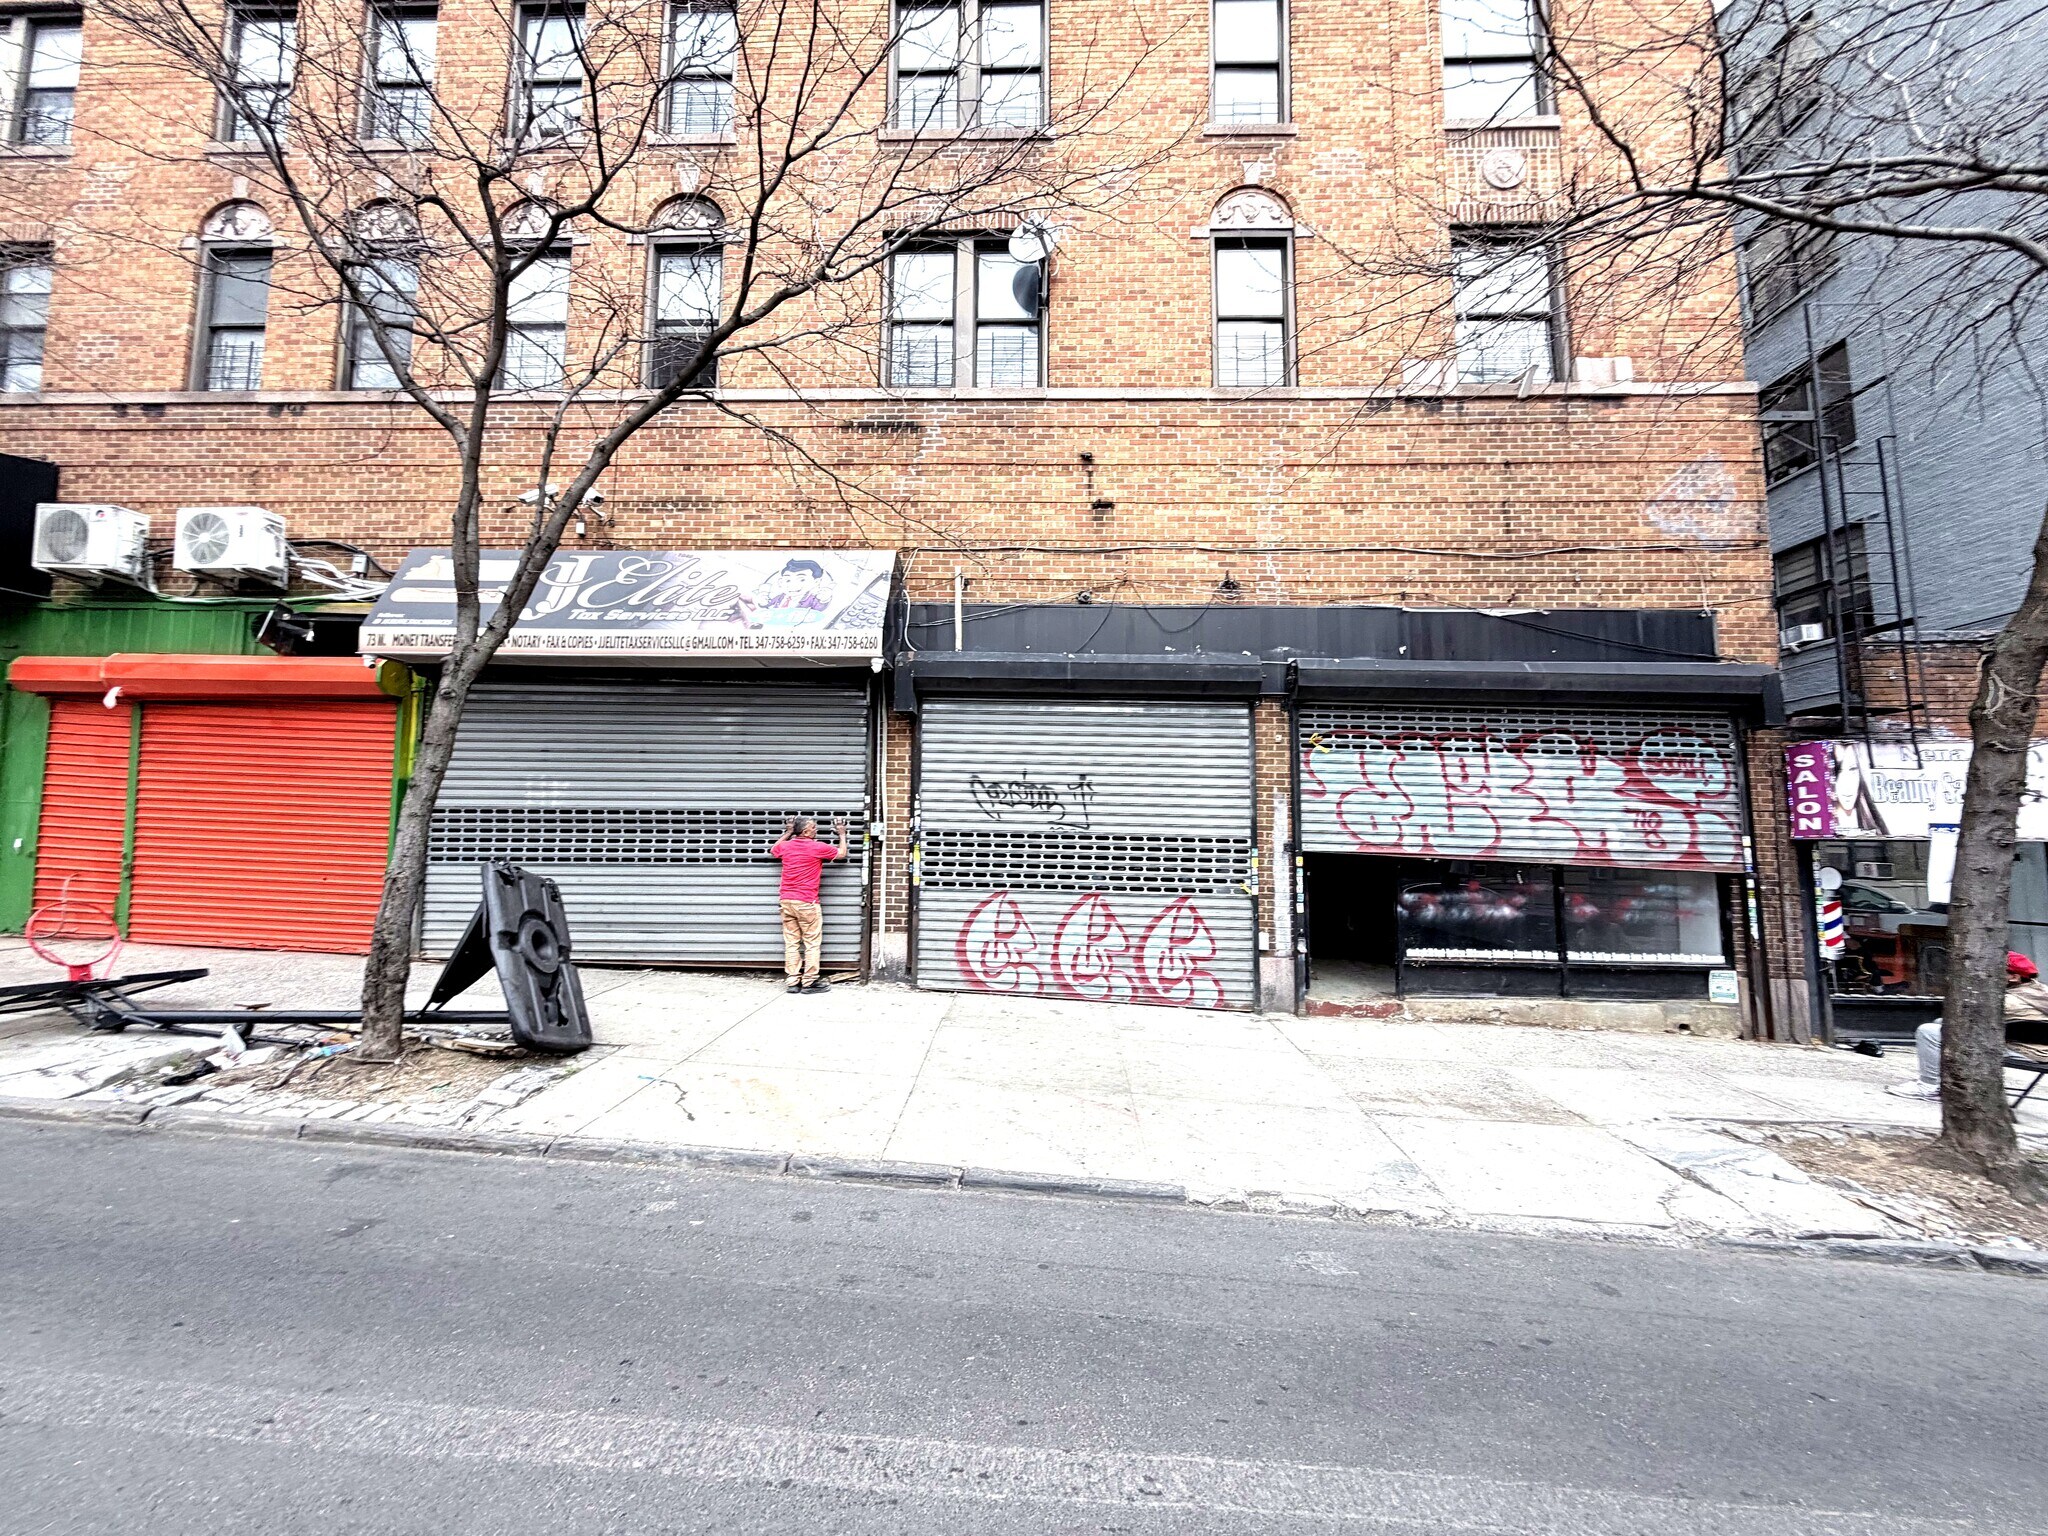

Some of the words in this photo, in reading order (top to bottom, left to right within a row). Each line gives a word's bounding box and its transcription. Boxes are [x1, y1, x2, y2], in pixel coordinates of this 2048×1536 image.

[576, 556, 741, 609] Elite
[568, 608, 604, 621] Tax
[602, 608, 691, 622] Services
[691, 608, 735, 622] LLC
[391, 633, 419, 647] MONEY
[419, 634, 457, 647] TRANSFE
[511, 635, 541, 648] NOTARY
[545, 635, 560, 649] FAX
[567, 636, 593, 649] COPIES
[755, 636, 805, 649] 347-758-6259
[827, 636, 878, 649] 347-758-6260
[1793, 754, 1823, 830] SALON
[1870, 771, 1938, 812] Beauty
